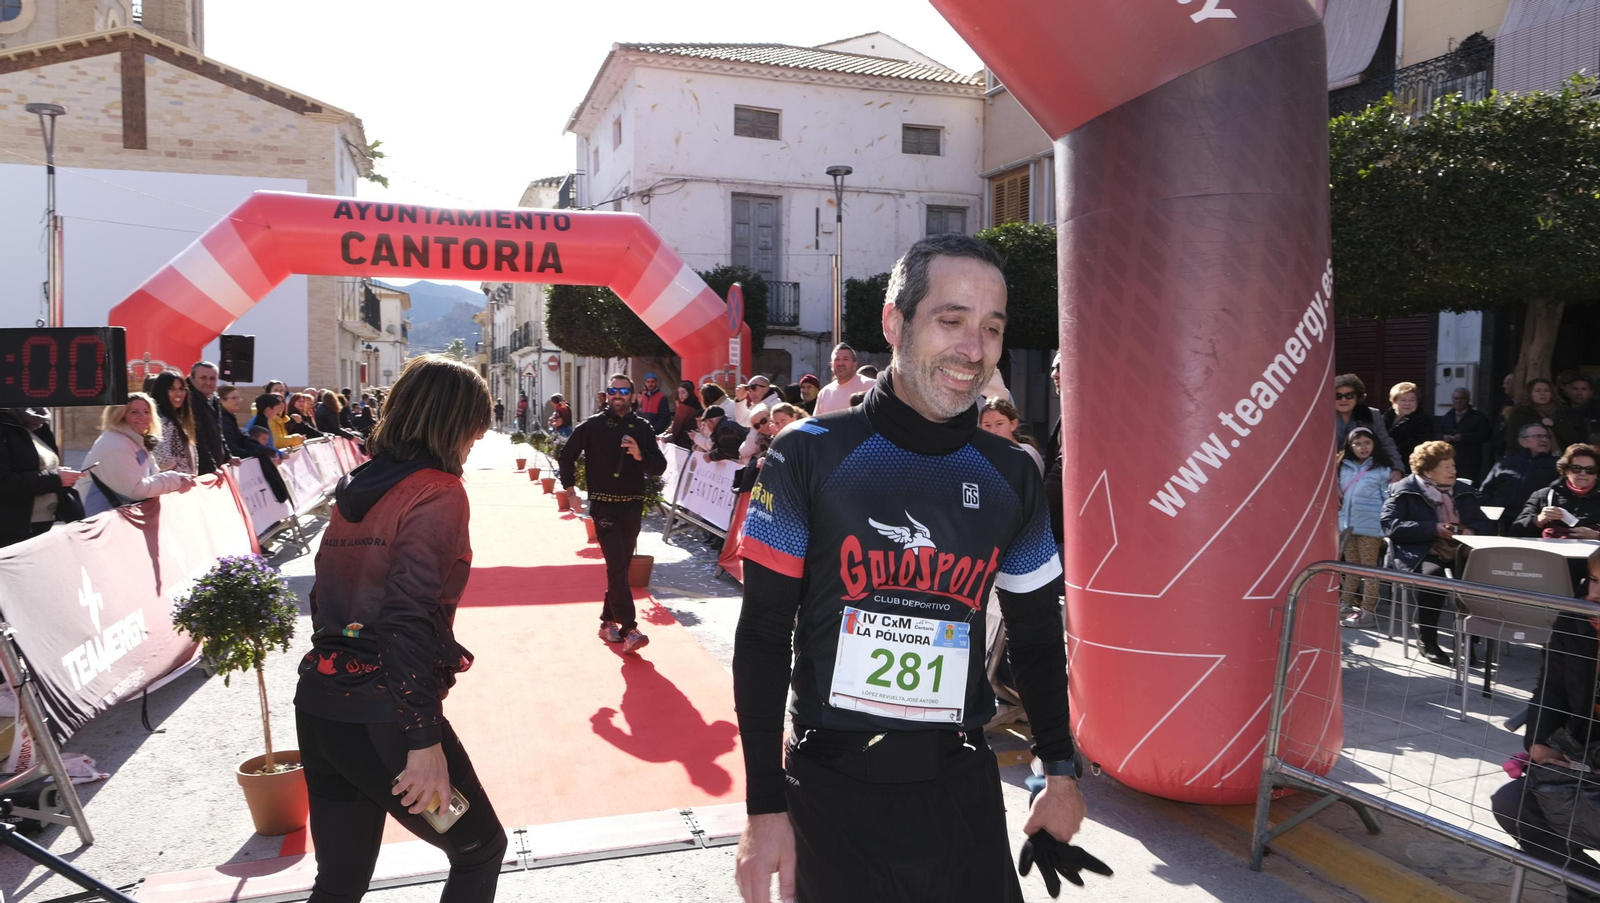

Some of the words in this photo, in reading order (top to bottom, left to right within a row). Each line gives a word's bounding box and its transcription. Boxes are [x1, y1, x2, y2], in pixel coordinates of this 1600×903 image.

[333, 201, 571, 231] AYUNTAMIENTO
[340, 231, 563, 274] CANTORIA
[1148, 258, 1333, 518] www.teamergy.es
[689, 477, 733, 512] CANTORIA
[873, 595, 900, 605] CLUB
[901, 598, 951, 611] DEPORTIVO
[856, 625, 872, 638] LA
[875, 629, 931, 646] PÓLVORA
[862, 612, 878, 625] IV
[881, 615, 912, 630] CxM
[865, 647, 944, 693] 281
